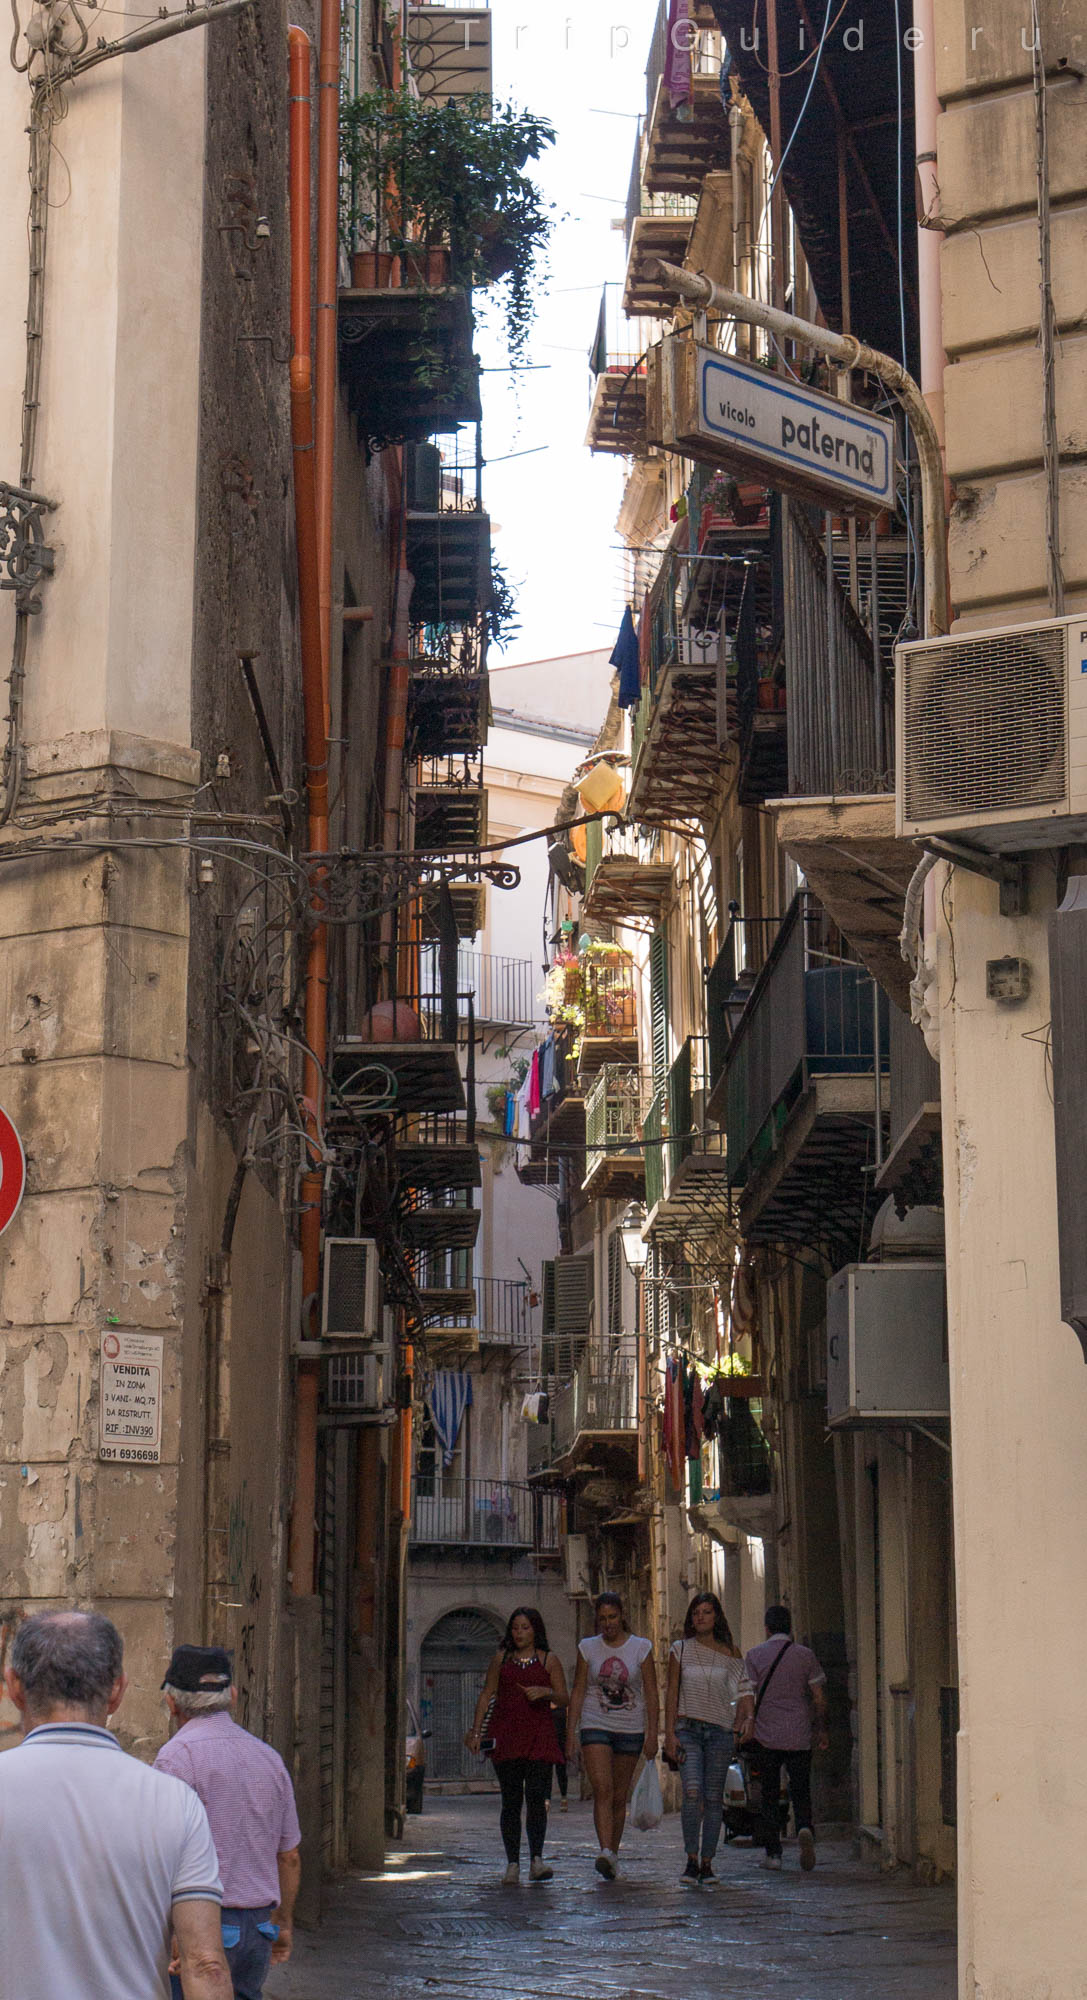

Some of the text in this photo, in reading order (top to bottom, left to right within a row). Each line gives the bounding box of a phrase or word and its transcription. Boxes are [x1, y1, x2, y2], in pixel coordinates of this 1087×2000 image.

[719, 401, 756, 429] vicolo
[113, 1364, 151, 1377] VENDITA
[115, 1380, 146, 1390] IN ZONA
[104, 1393, 109, 1401] 3
[106, 1408, 116, 1417] DA
[100, 1448, 159, 1461] 091 6936698
